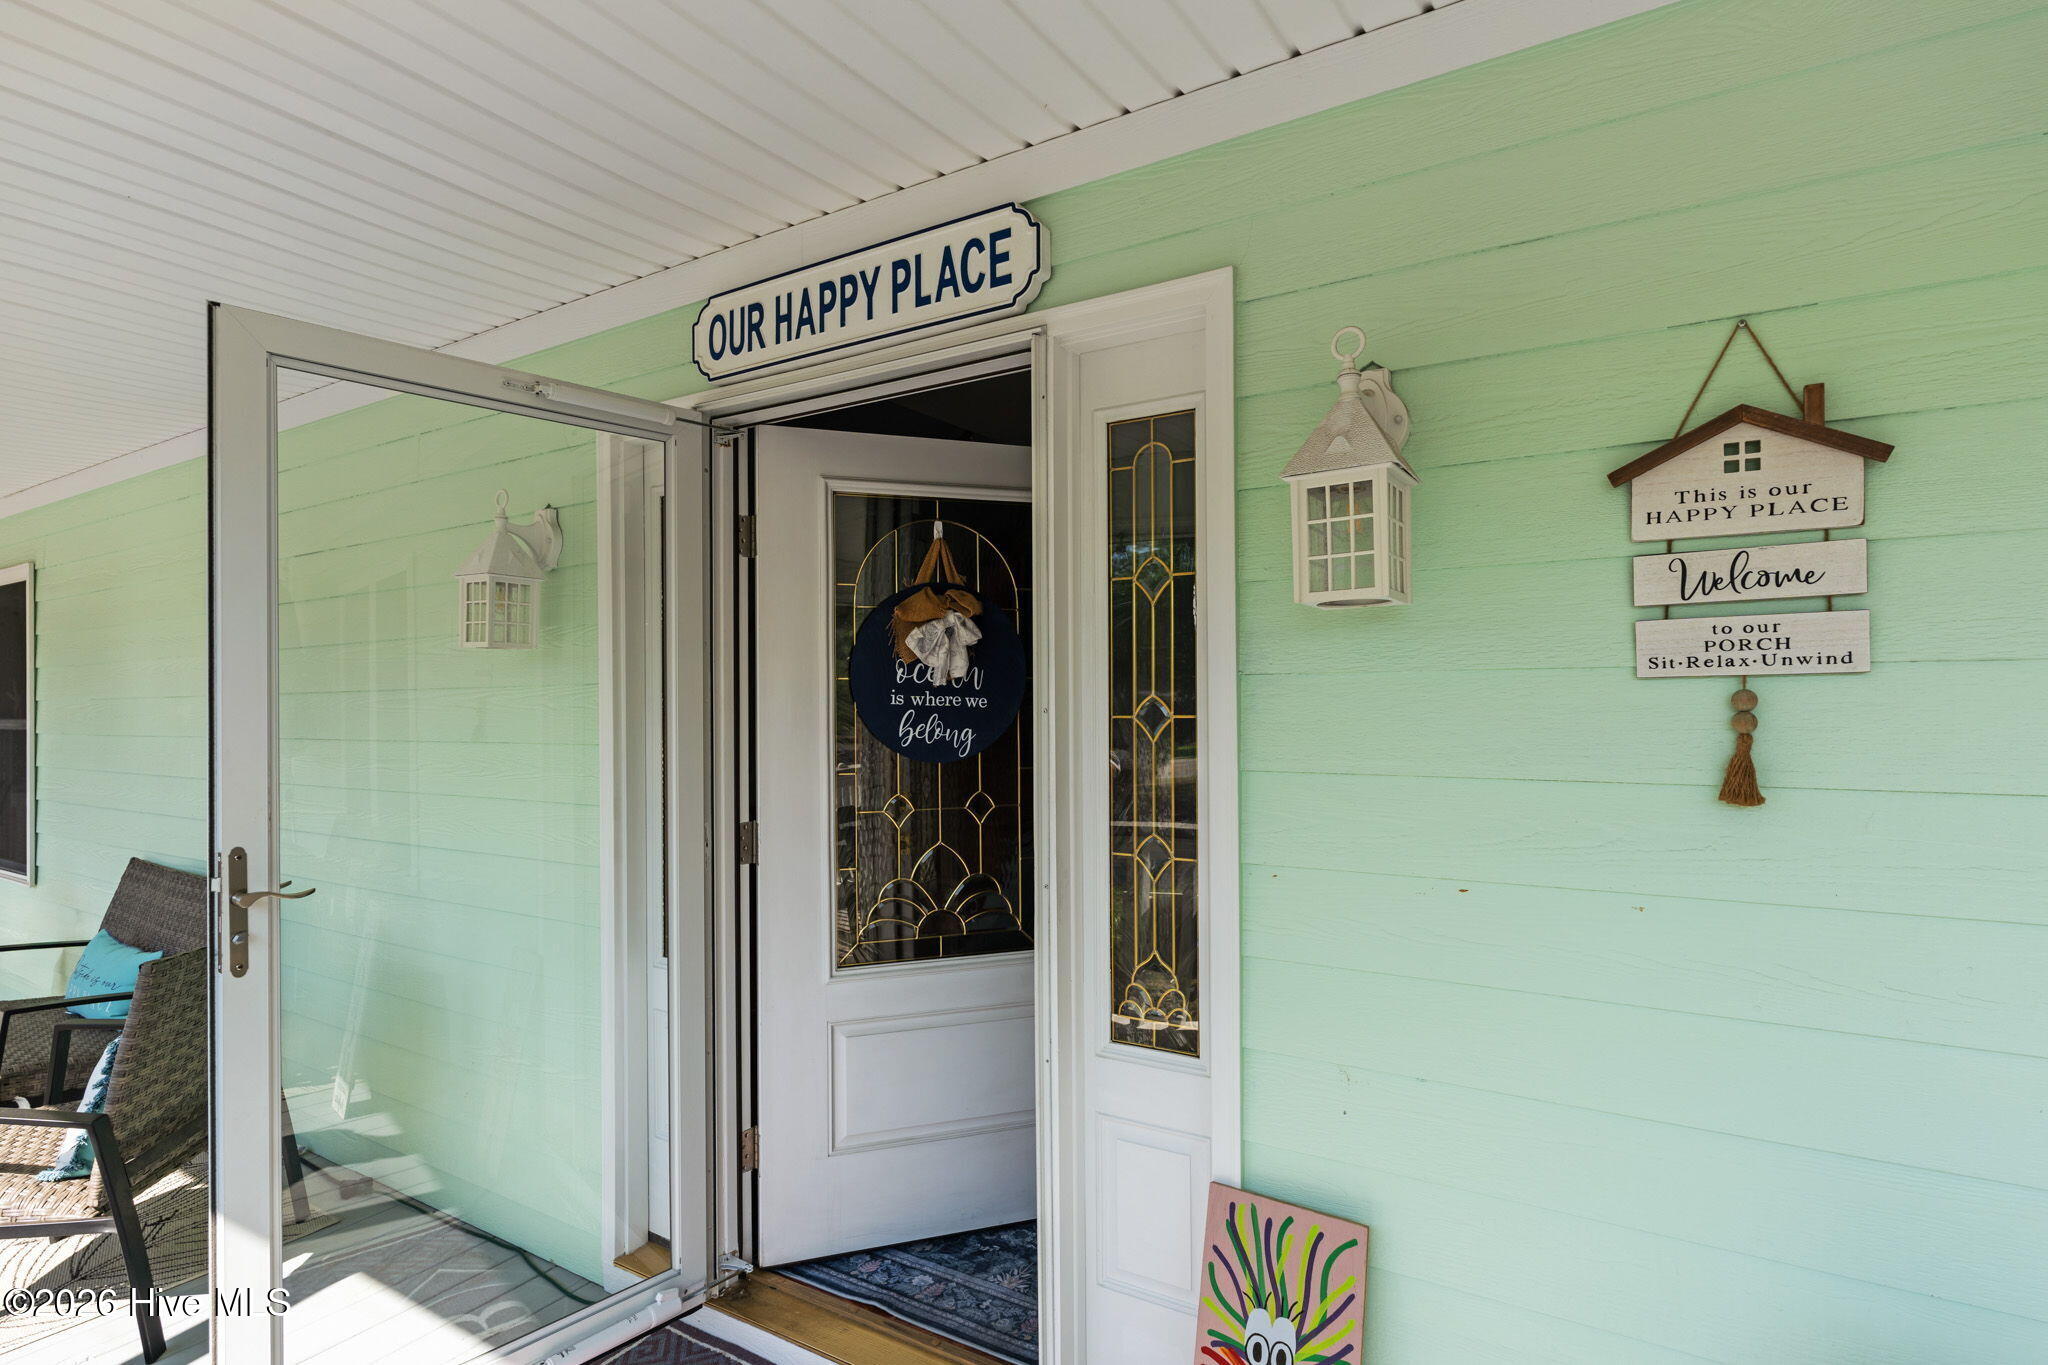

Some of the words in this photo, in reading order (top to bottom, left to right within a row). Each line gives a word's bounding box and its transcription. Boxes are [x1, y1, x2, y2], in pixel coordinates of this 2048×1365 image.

[708, 302, 766, 360] OUR
[775, 265, 882, 345] HAPPY
[891, 227, 1012, 314] PLACE
[1674, 488, 1727, 504] This
[1740, 485, 1757, 499] is
[1768, 483, 1813, 496] our
[1645, 505, 1737, 525] HAPPY
[1750, 496, 1849, 517] PLACE
[1668, 550, 1826, 601] Welcome
[1712, 624, 1733, 635] to
[1742, 622, 1781, 634] our
[1704, 637, 1791, 652] PORCH
[890, 689, 904, 705] is
[910, 691, 961, 707] where
[965, 696, 988, 708] we
[898, 709, 976, 757] belong
